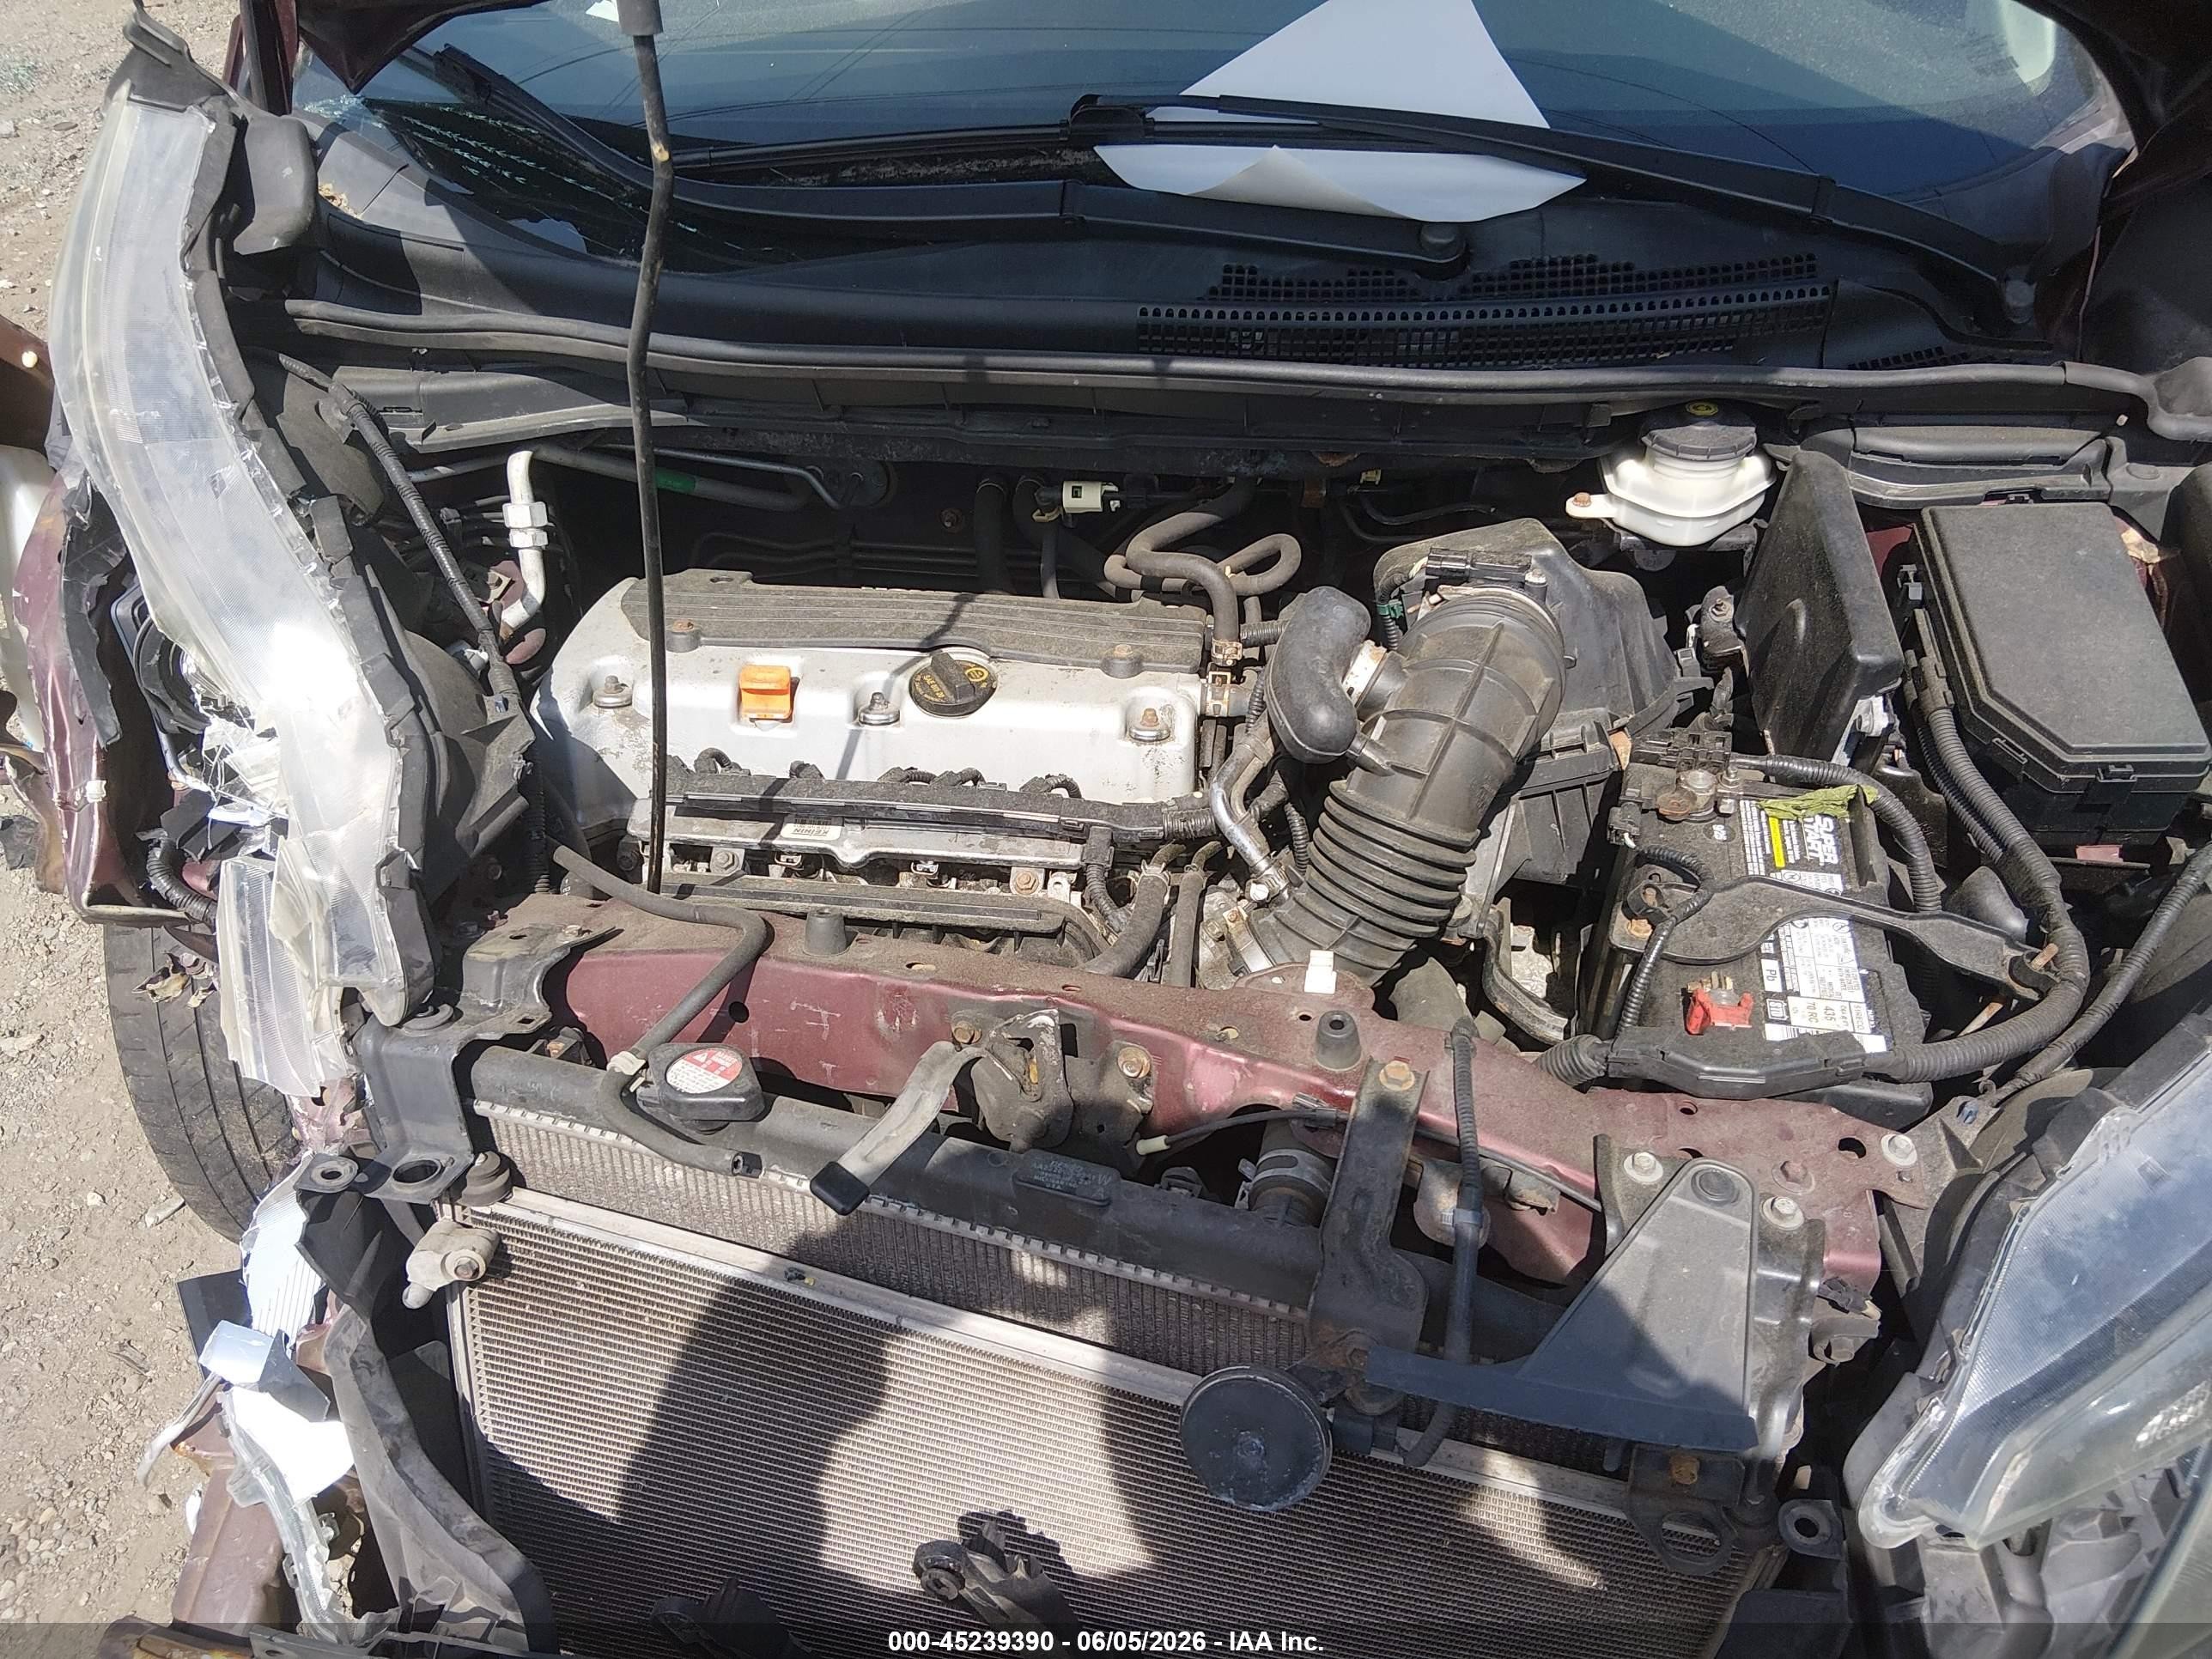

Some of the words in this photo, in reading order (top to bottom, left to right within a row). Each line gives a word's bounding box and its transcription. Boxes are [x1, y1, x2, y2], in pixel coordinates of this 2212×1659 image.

[1820, 817, 1838, 864] SUPER
[1765, 969, 1777, 981] Pb
[1824, 1006, 1836, 1022] 435
